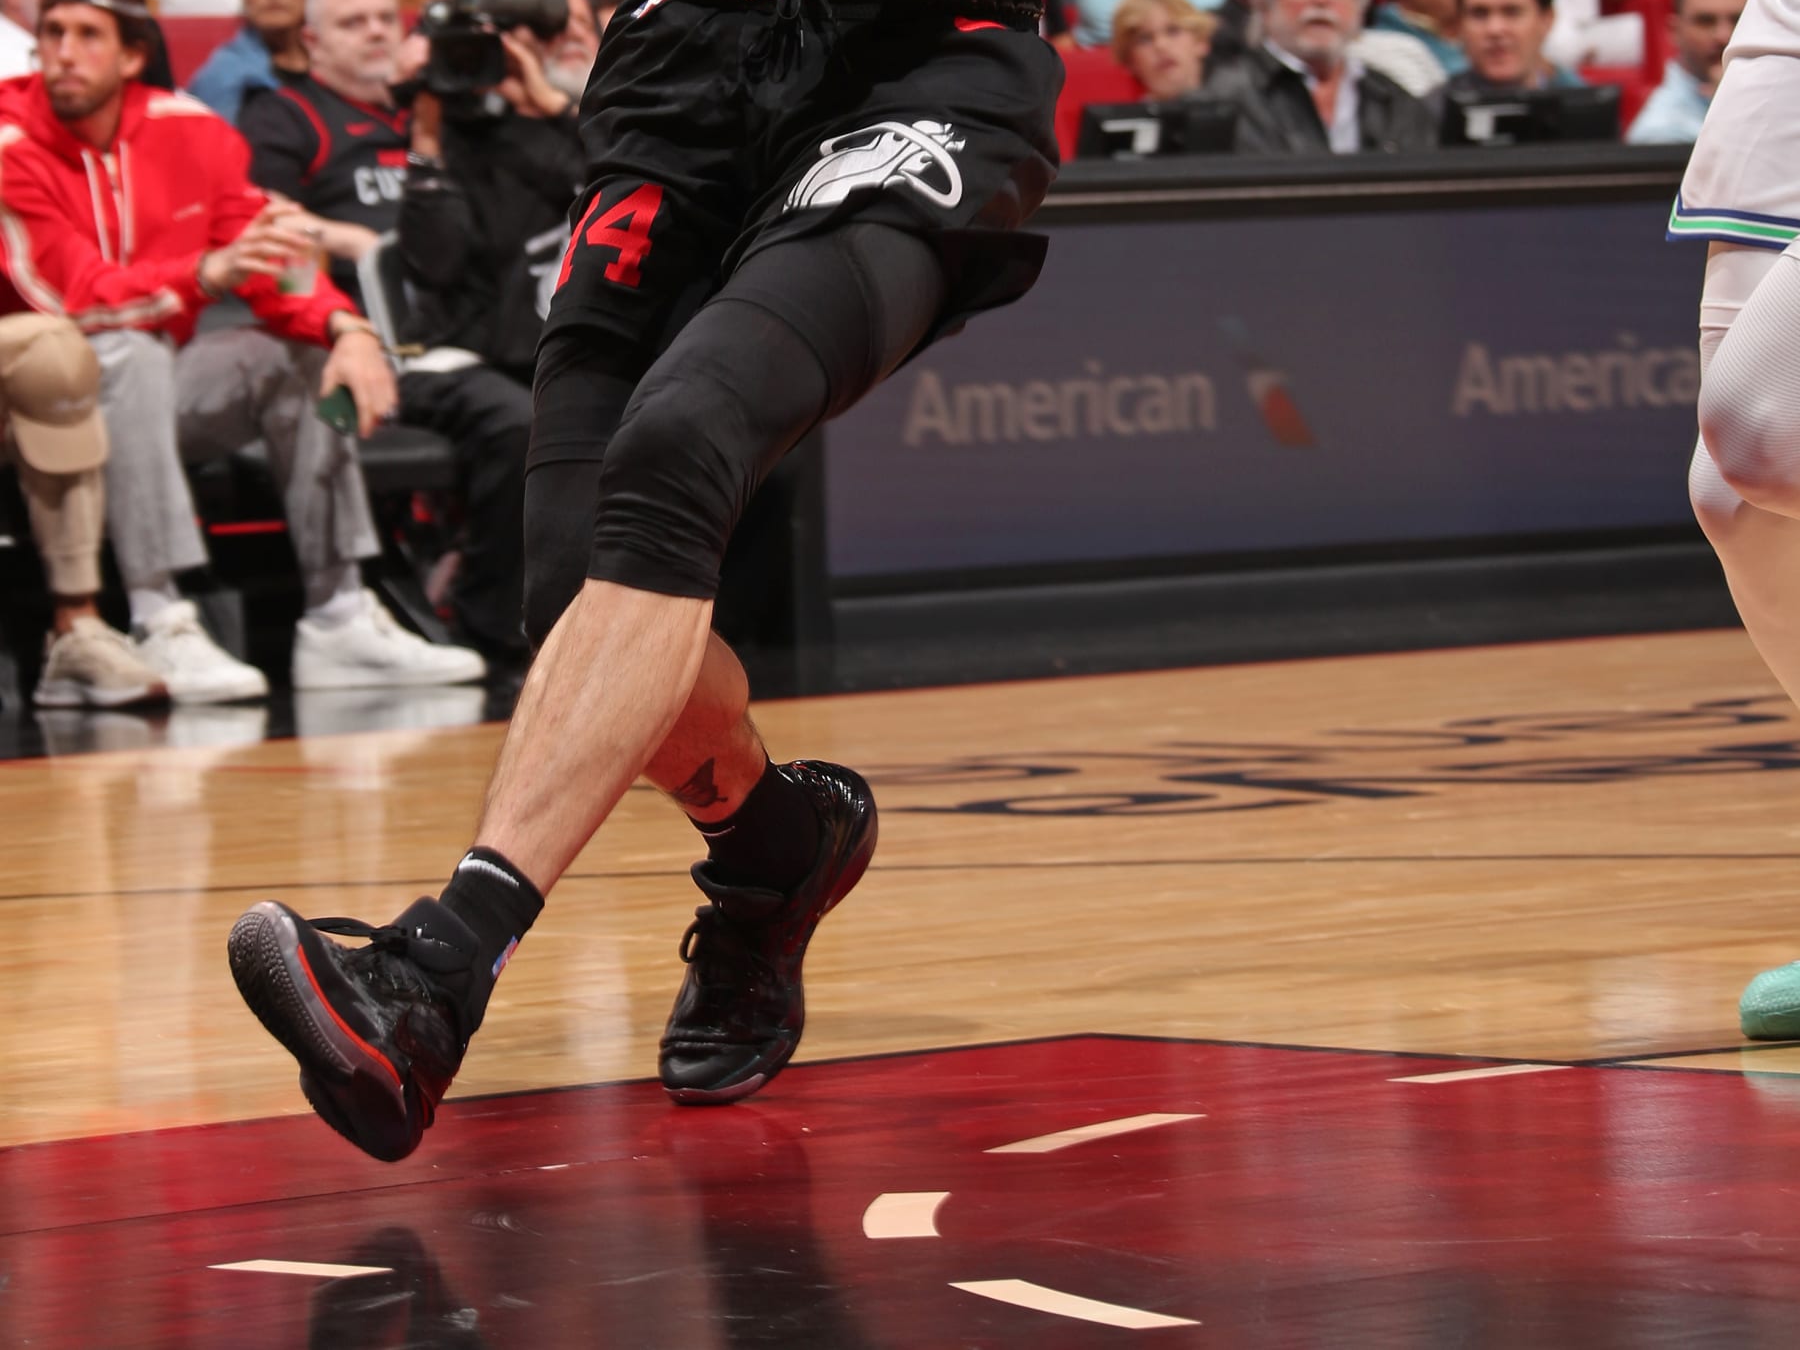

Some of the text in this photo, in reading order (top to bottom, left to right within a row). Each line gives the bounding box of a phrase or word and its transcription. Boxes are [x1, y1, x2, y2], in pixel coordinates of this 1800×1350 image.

[556, 183, 664, 291] 14
[903, 358, 1217, 447] American
[1453, 330, 1700, 417] America
